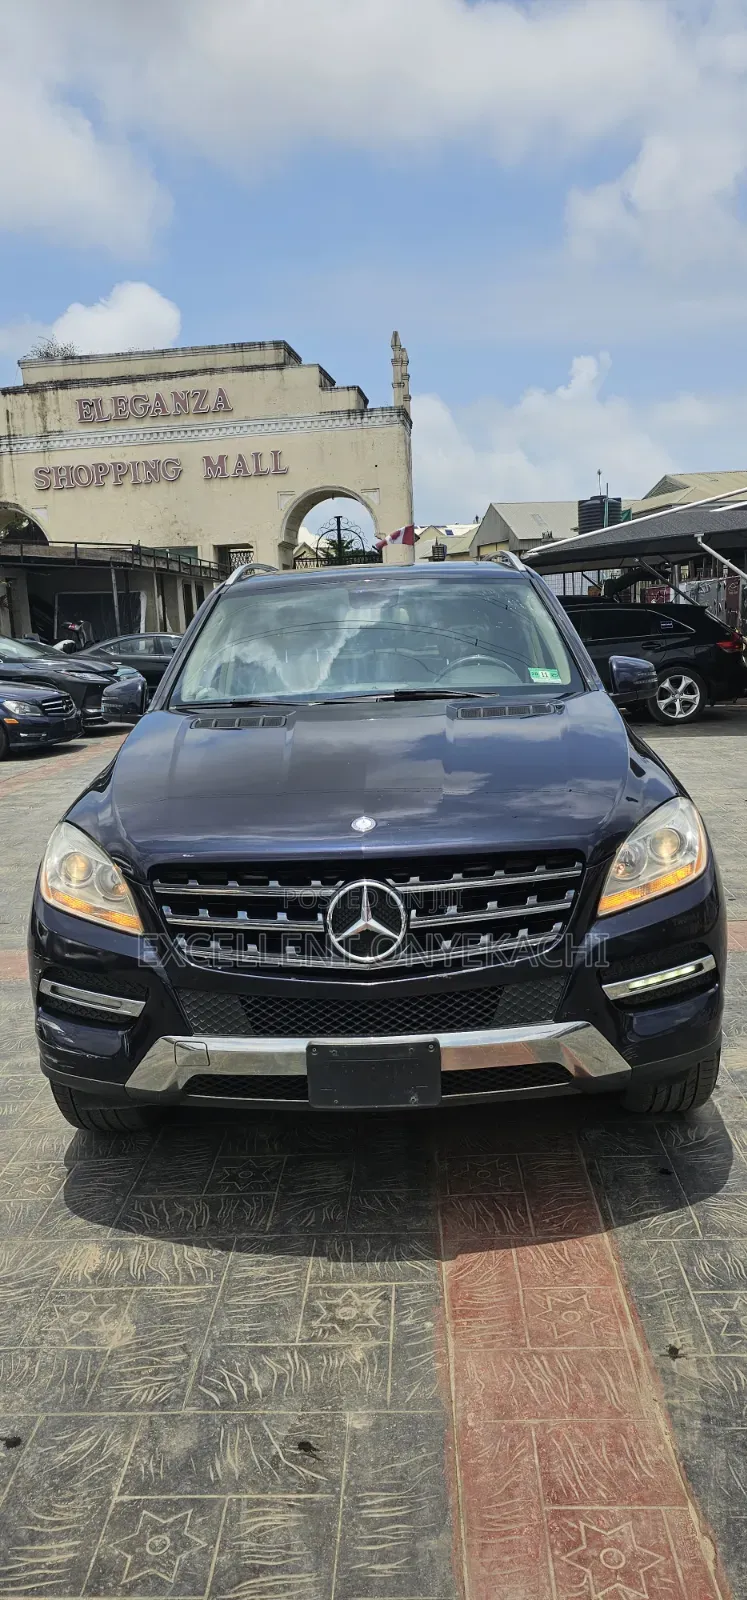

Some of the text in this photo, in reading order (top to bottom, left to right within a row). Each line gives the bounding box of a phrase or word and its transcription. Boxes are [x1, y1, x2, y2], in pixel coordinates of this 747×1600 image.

[75, 386, 234, 424] ELEGANZA
[33, 449, 289, 491] SHOPPING MALL
